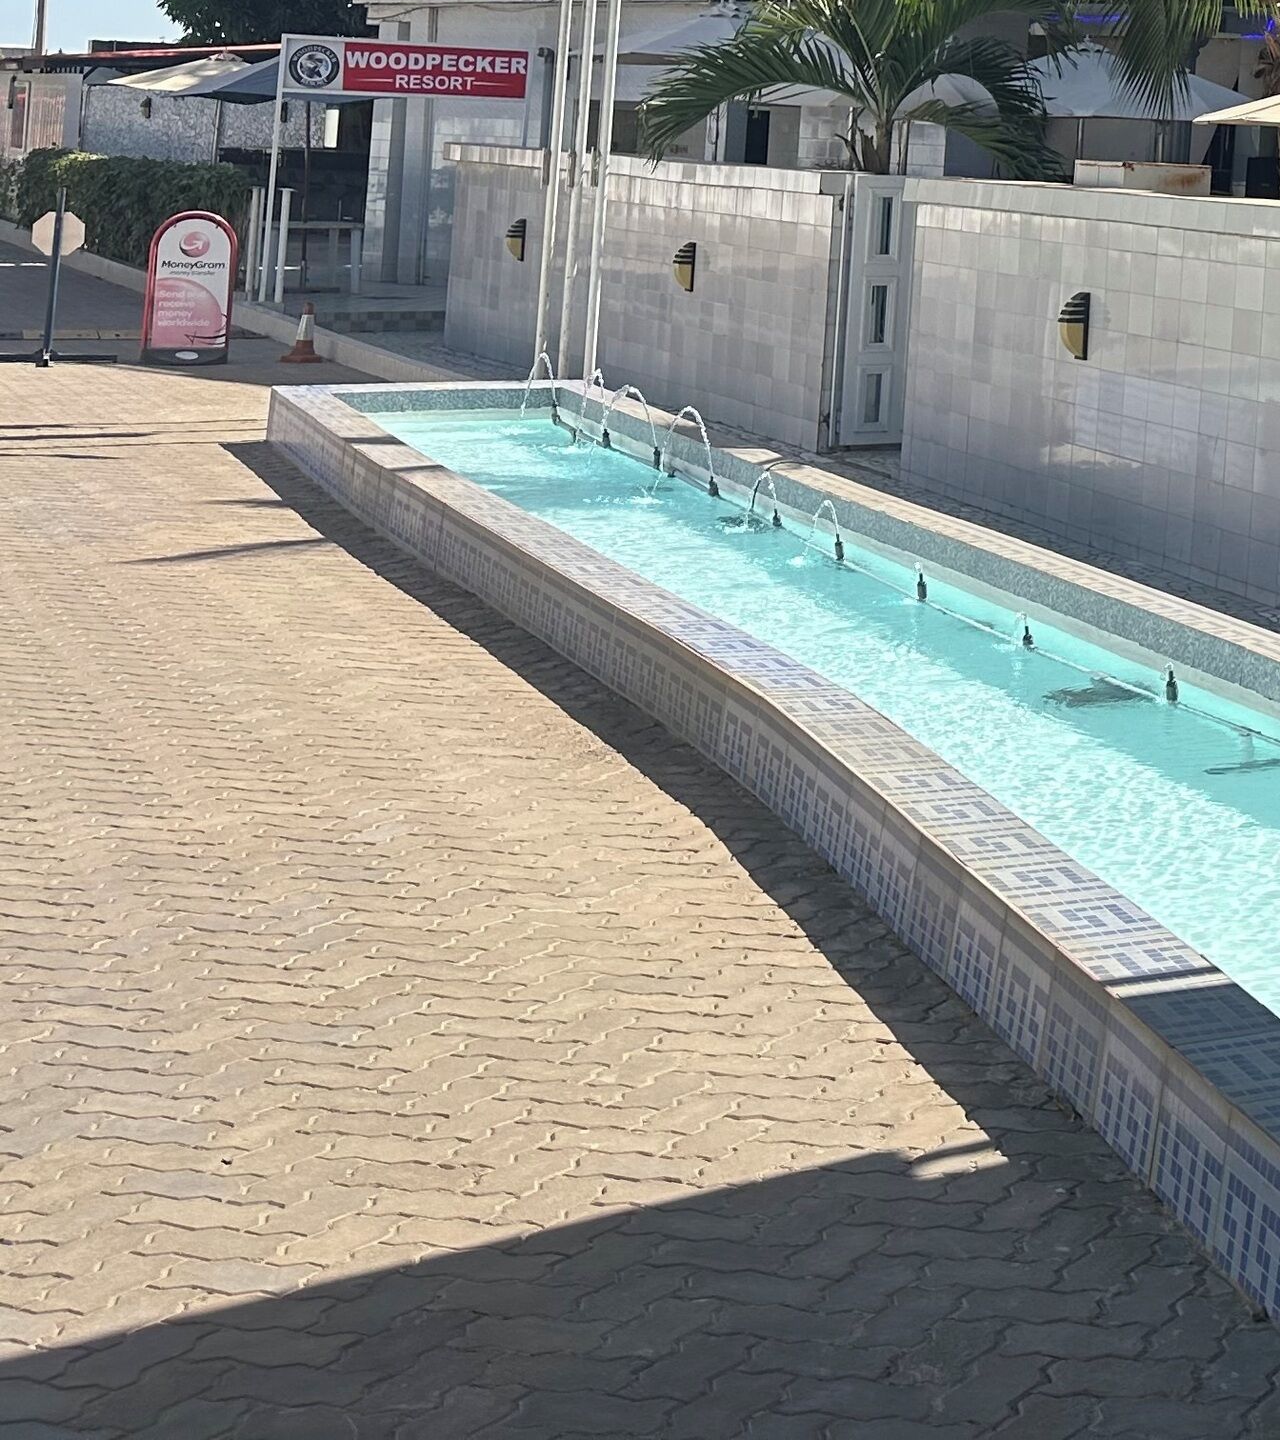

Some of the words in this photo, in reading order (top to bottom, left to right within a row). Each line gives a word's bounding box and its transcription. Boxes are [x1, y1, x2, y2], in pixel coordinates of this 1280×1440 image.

[346, 51, 527, 74] WOODPECKER
[395, 74, 475, 90] RESORT
[161, 260, 226, 270] MoneyGram
[159, 290, 185, 298] Send
[158, 310, 192, 319] money
